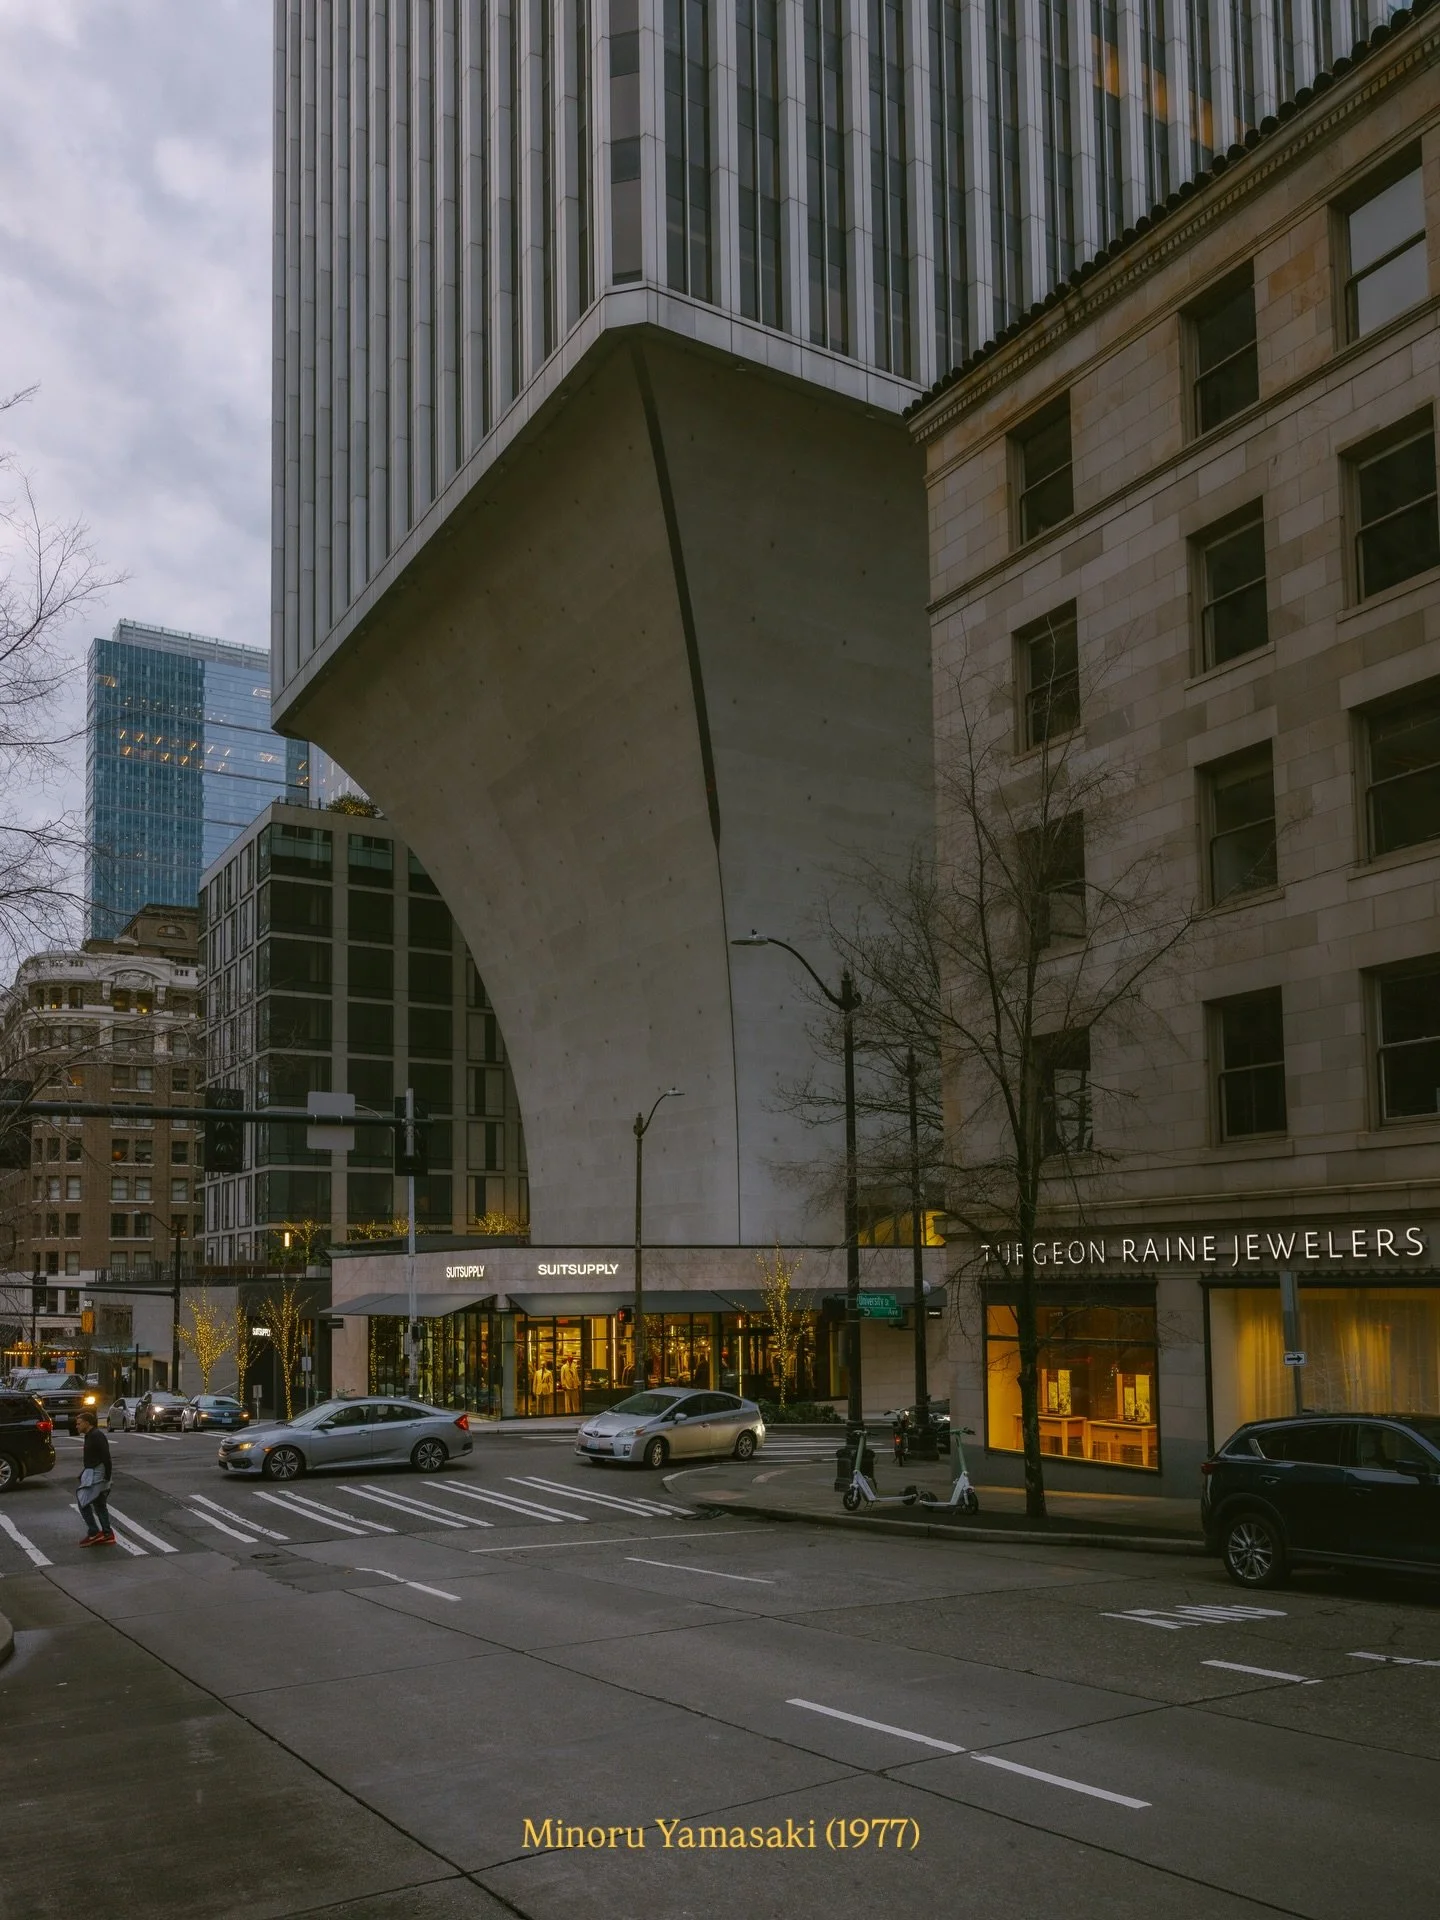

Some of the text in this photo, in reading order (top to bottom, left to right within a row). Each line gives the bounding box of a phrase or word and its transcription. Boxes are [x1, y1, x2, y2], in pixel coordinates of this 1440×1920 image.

[1122, 1235, 1216, 1263] RAINE
[1231, 1227, 1424, 1267] JEWELERS
[446, 1265, 485, 1278] SUITSUPPLY
[537, 1263, 619, 1275] SUITSUPPLY
[858, 1295, 884, 1307] University
